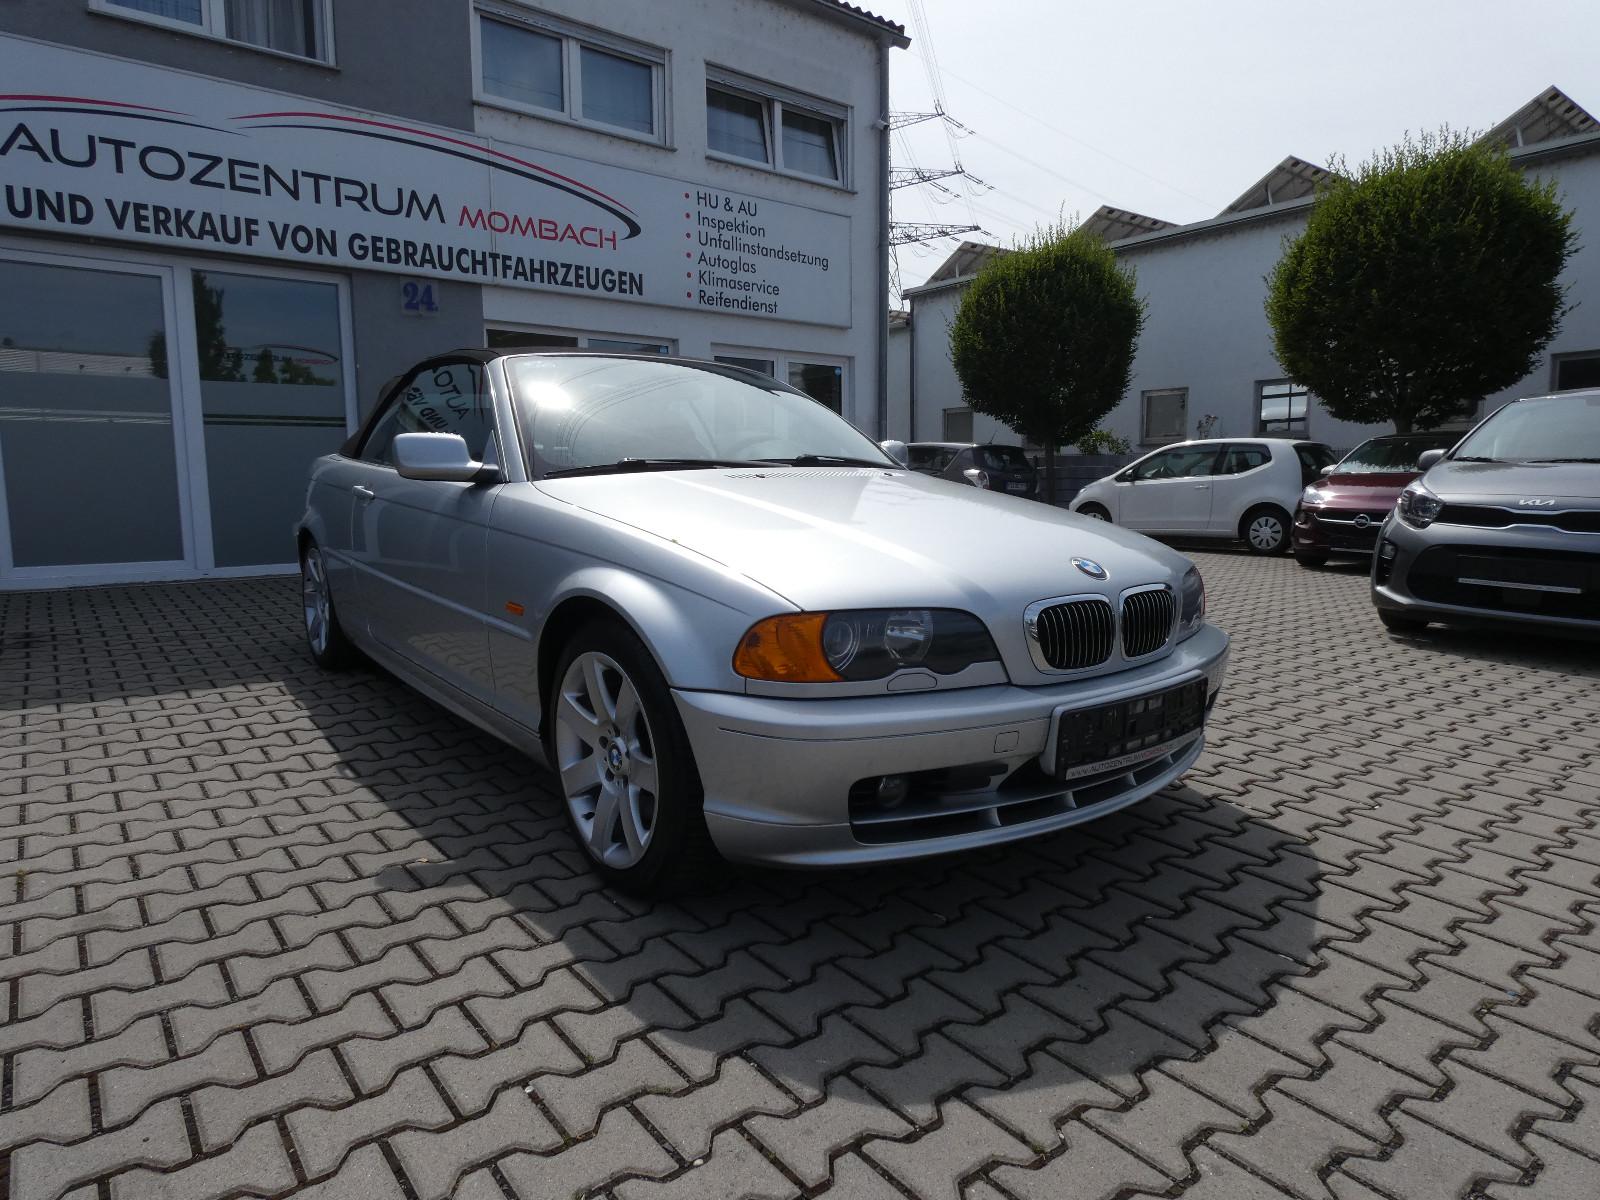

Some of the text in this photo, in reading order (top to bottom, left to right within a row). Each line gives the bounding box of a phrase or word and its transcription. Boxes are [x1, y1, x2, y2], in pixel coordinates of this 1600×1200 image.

[1, 122, 617, 251] AUTOZENTRUM MOMBACH
[696, 191, 757, 217] HU & AU
[697, 211, 766, 238] Inspektion
[5, 184, 644, 296] UND VERKAUF VON GEBRAUCHTFAHRZEUGEN
[698, 230, 829, 271] Unfallinstandsetzung
[697, 251, 757, 275] Autoglas
[698, 270, 780, 296] Klimaservice
[698, 289, 778, 314] Reifendienst
